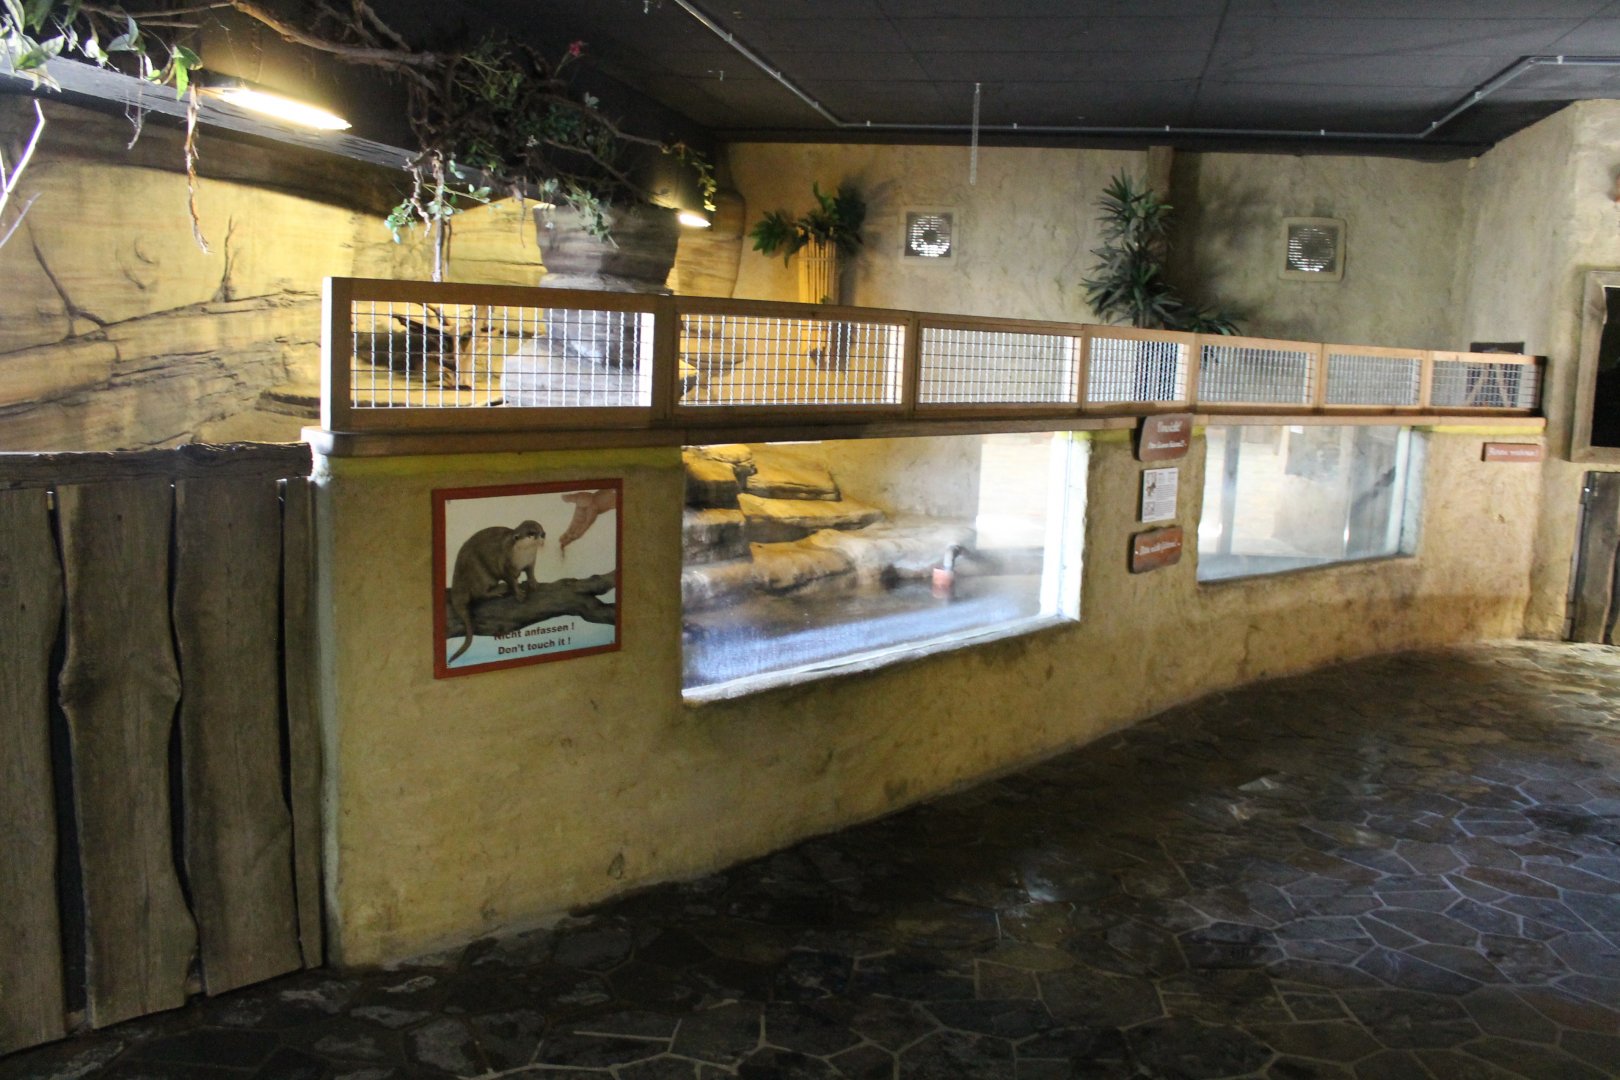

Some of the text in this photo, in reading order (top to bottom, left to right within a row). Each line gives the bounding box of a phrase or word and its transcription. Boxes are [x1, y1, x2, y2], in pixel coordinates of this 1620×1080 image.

[494, 630, 522, 641] Nicht
[525, 624, 569, 637] anfassen
[498, 643, 525, 654] Don't
[527, 639, 555, 651] touch
[558, 638, 565, 646] it
